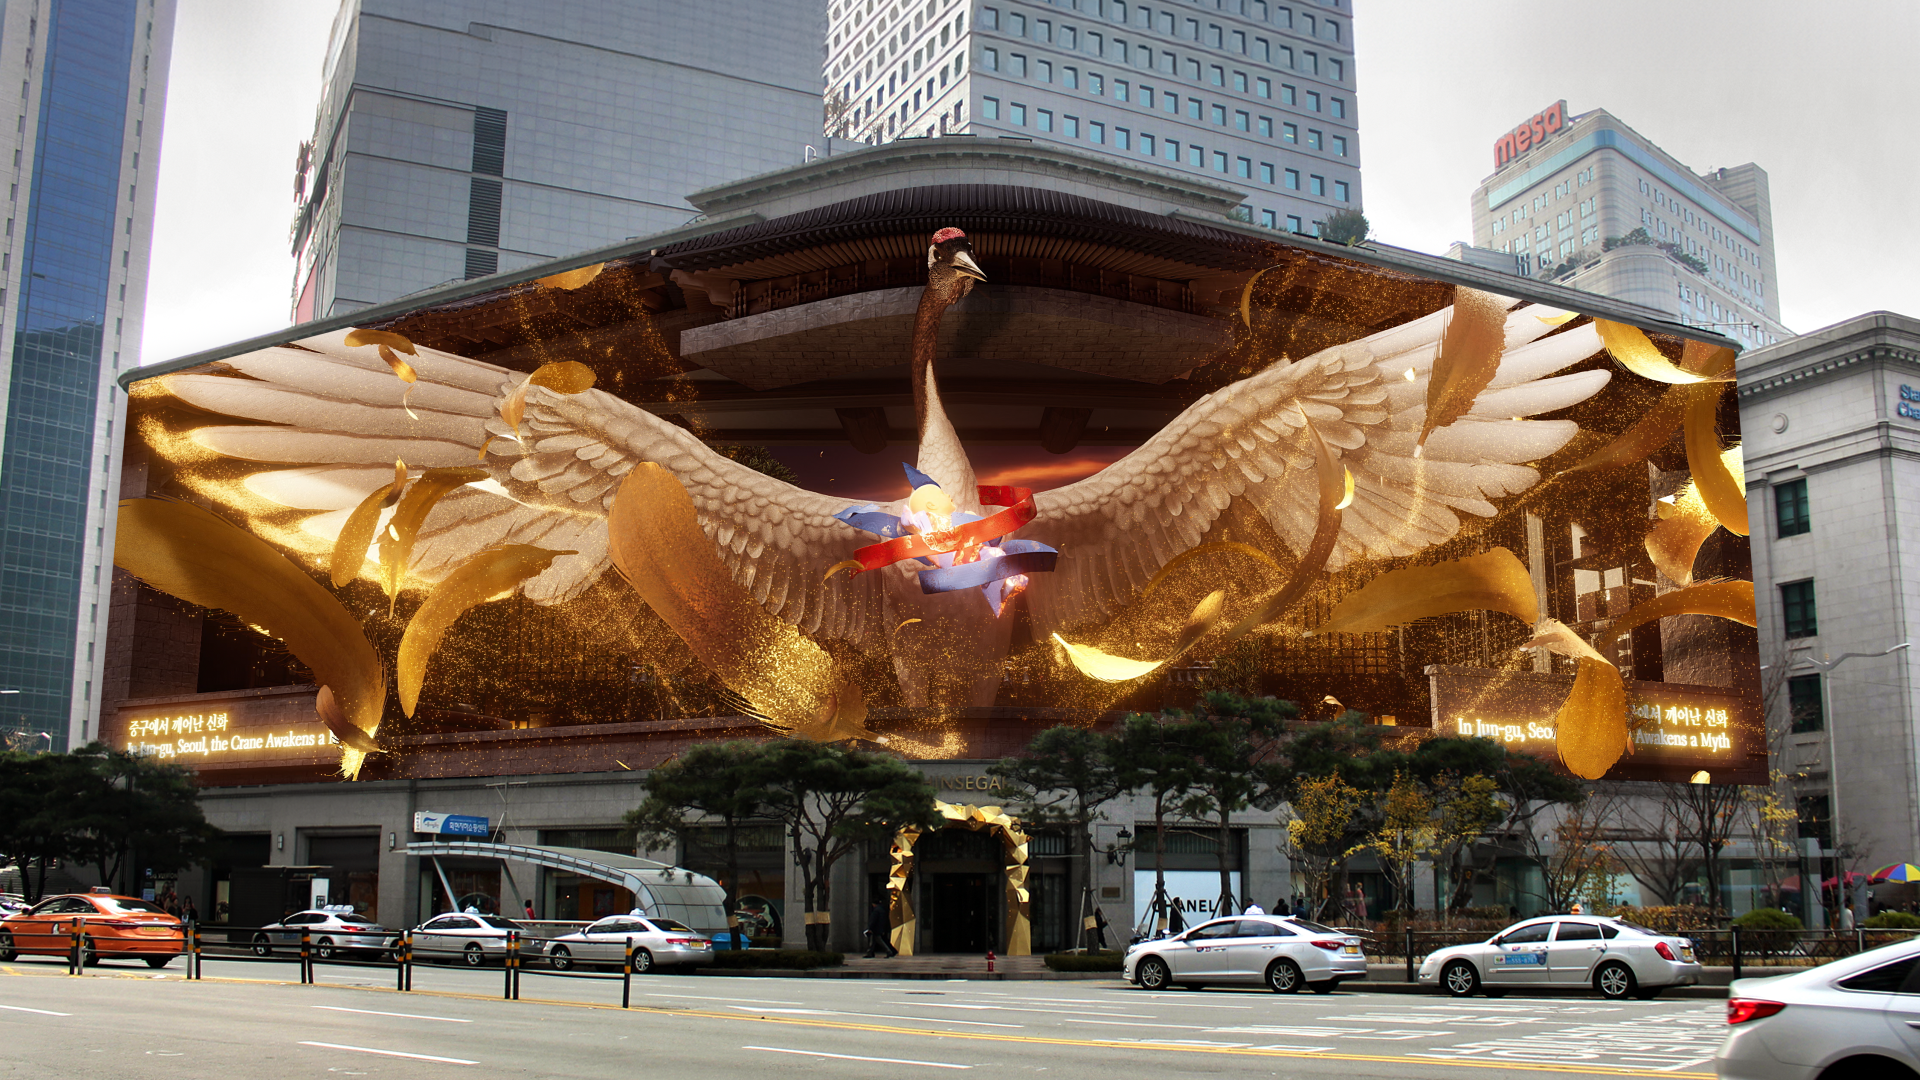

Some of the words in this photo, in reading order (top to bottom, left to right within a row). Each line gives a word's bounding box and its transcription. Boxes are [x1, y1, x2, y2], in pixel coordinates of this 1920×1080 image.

[1494, 103, 1562, 168] mesa
[129, 718, 169, 737] 중구에서
[172, 715, 203, 734] 깨어난
[206, 713, 228, 732] 신화
[1665, 706, 1701, 726] 깨어난
[1705, 709, 1728, 728] 신화
[140, 742, 175, 759] Jun-gu,
[177, 737, 208, 756] Seoul,
[210, 735, 228, 751] the
[231, 735, 263, 751] Crane
[265, 730, 315, 748] Awakens
[318, 734, 325, 746] a
[1458, 718, 1473, 735] In
[1476, 719, 1525, 742] Jun-gu,
[1635, 729, 1687, 746] Awakens
[1690, 735, 1698, 747] a
[1701, 732, 1730, 752] Myth
[923, 776, 1007, 790] HINSEGA
